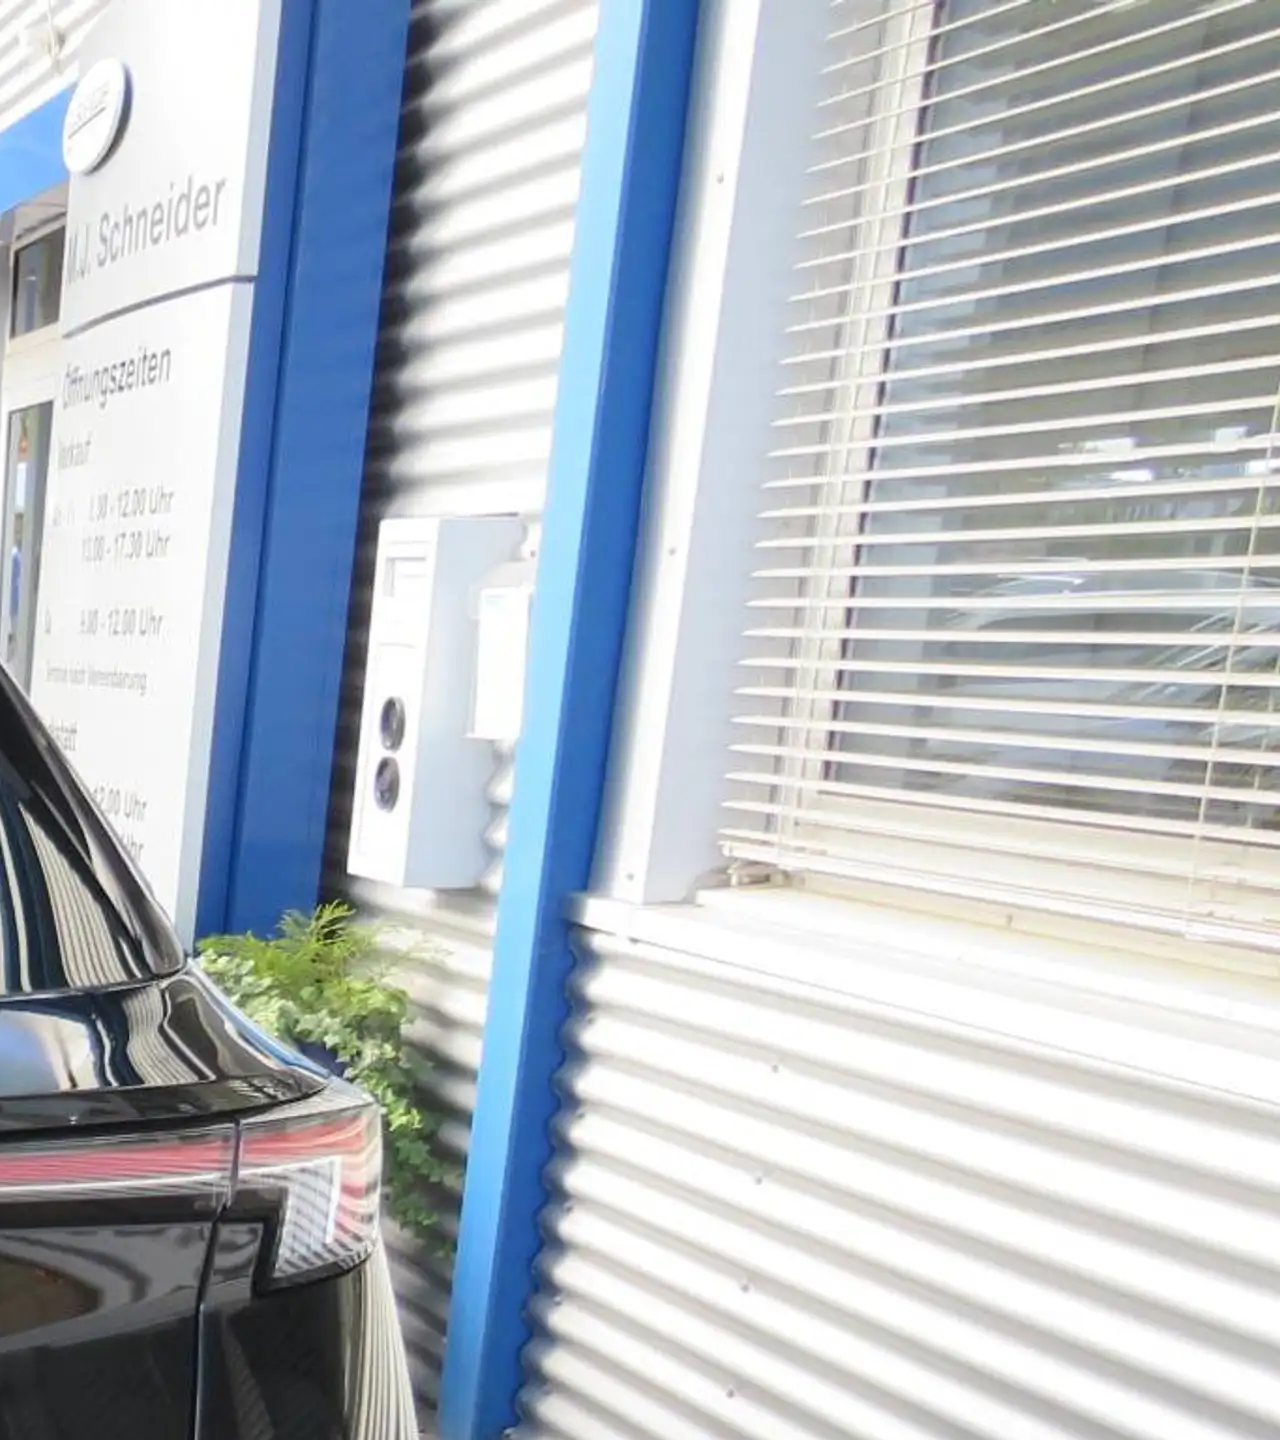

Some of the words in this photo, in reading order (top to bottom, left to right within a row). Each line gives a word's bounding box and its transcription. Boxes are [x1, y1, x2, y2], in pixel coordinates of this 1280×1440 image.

[96, 173, 228, 269] Schneider
[61, 347, 172, 411] Öffnungszeiten
[117, 488, 148, 518] 12.00
[148, 481, 175, 515] Uhr
[114, 530, 143, 560] 17.30
[145, 528, 172, 559] Uhr
[107, 607, 136, 637] 12.00
[139, 604, 164, 637] Uhr
[123, 788, 148, 822] Uhr
